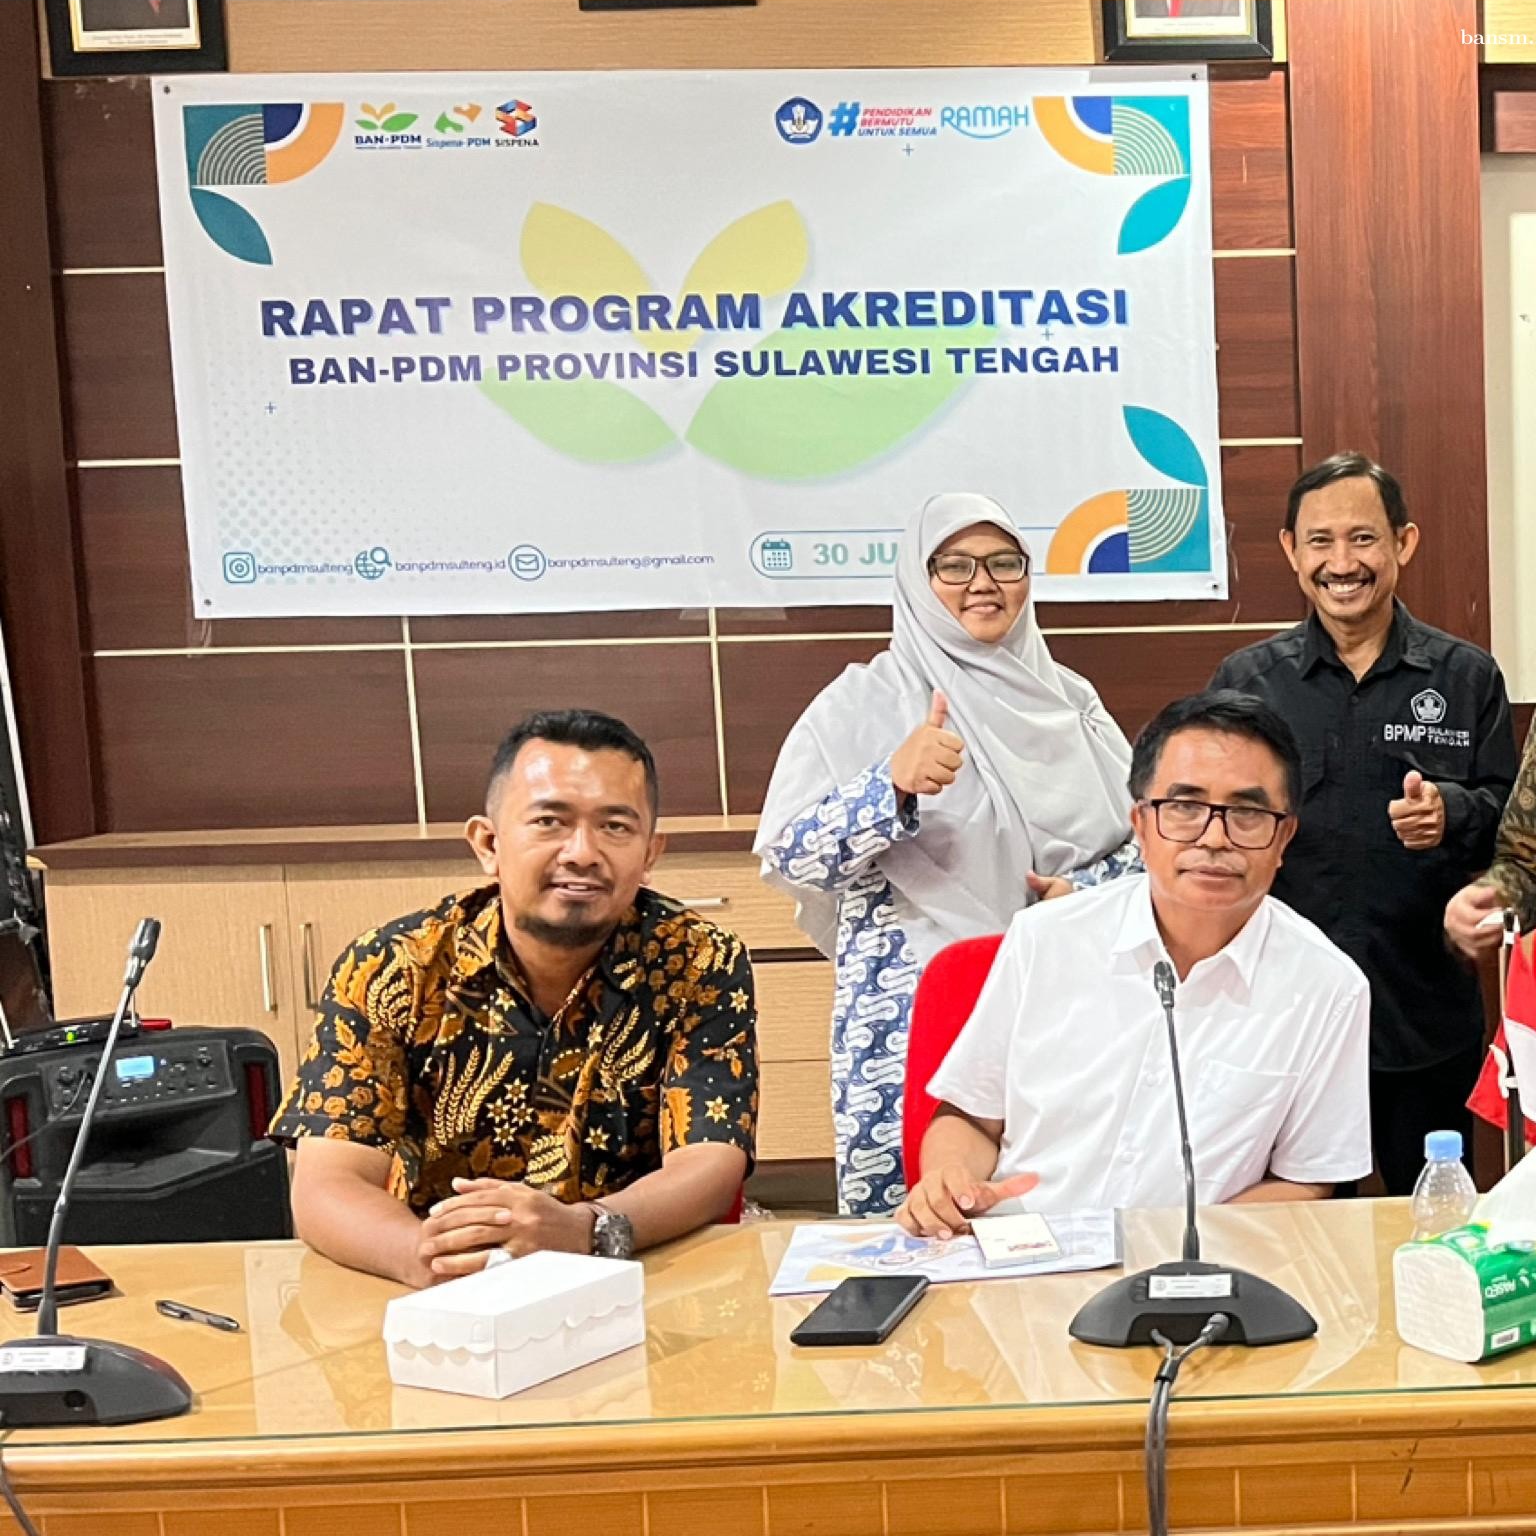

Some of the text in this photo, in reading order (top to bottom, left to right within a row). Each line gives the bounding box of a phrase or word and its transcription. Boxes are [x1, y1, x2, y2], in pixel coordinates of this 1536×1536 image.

[862, 107, 932, 117] PENDIDIKAN
[941, 105, 1029, 127] RAMAH
[860, 117, 914, 127] BERMUTU
[858, 127, 937, 137] UNTUK SEMUA
[260, 289, 1128, 337] RAPAT PROGRAM AKREDITASI
[289, 345, 1119, 385] BAN-PDM PROVINSI SULAWESI TENGAH
[812, 542, 849, 566] 30
[257, 564, 353, 576] banpdmsulteng
[1384, 724, 1427, 742] BPMP
